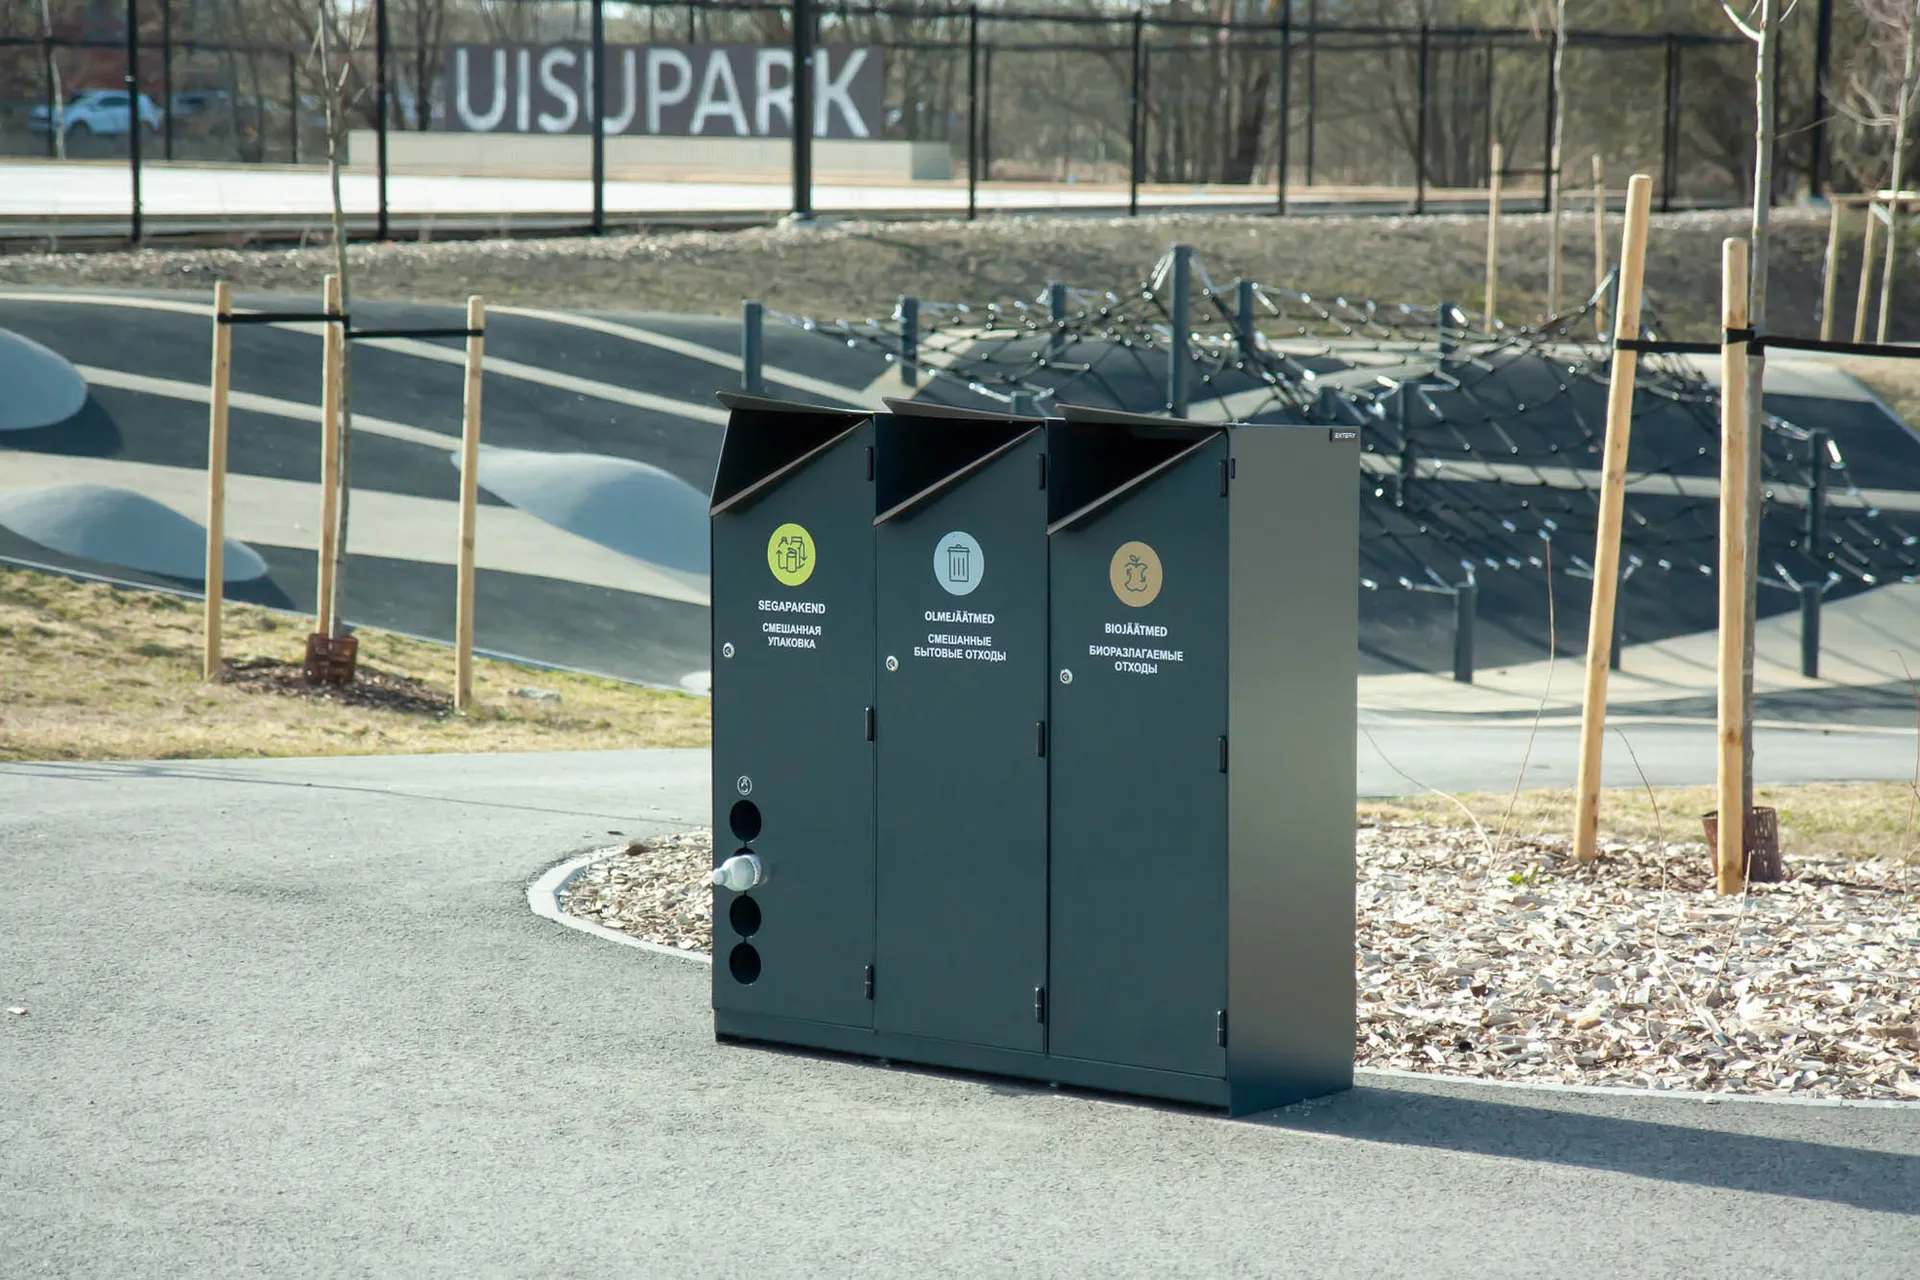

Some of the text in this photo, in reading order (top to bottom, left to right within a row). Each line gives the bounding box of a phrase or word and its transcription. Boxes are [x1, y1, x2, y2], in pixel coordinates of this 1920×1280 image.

[456, 47, 869, 137] UISUPARK
[758, 599, 826, 615] SEGAPAKEND
[924, 609, 995, 625] OLMEJÄÄTMED
[762, 622, 822, 637] СМЕШАННАЯ
[1104, 622, 1168, 638] BIOJÄÄTMED
[768, 636, 818, 650] УПАКОВКА
[928, 633, 992, 647] СМЕШАННЫЕ
[913, 646, 1007, 663] БЫТОВЫЕ ОТХОДЫ
[1088, 644, 1184, 662] БИОРАЗЛАГАЕМЫЕ
[1114, 660, 1158, 676] ОТХОДЫ
